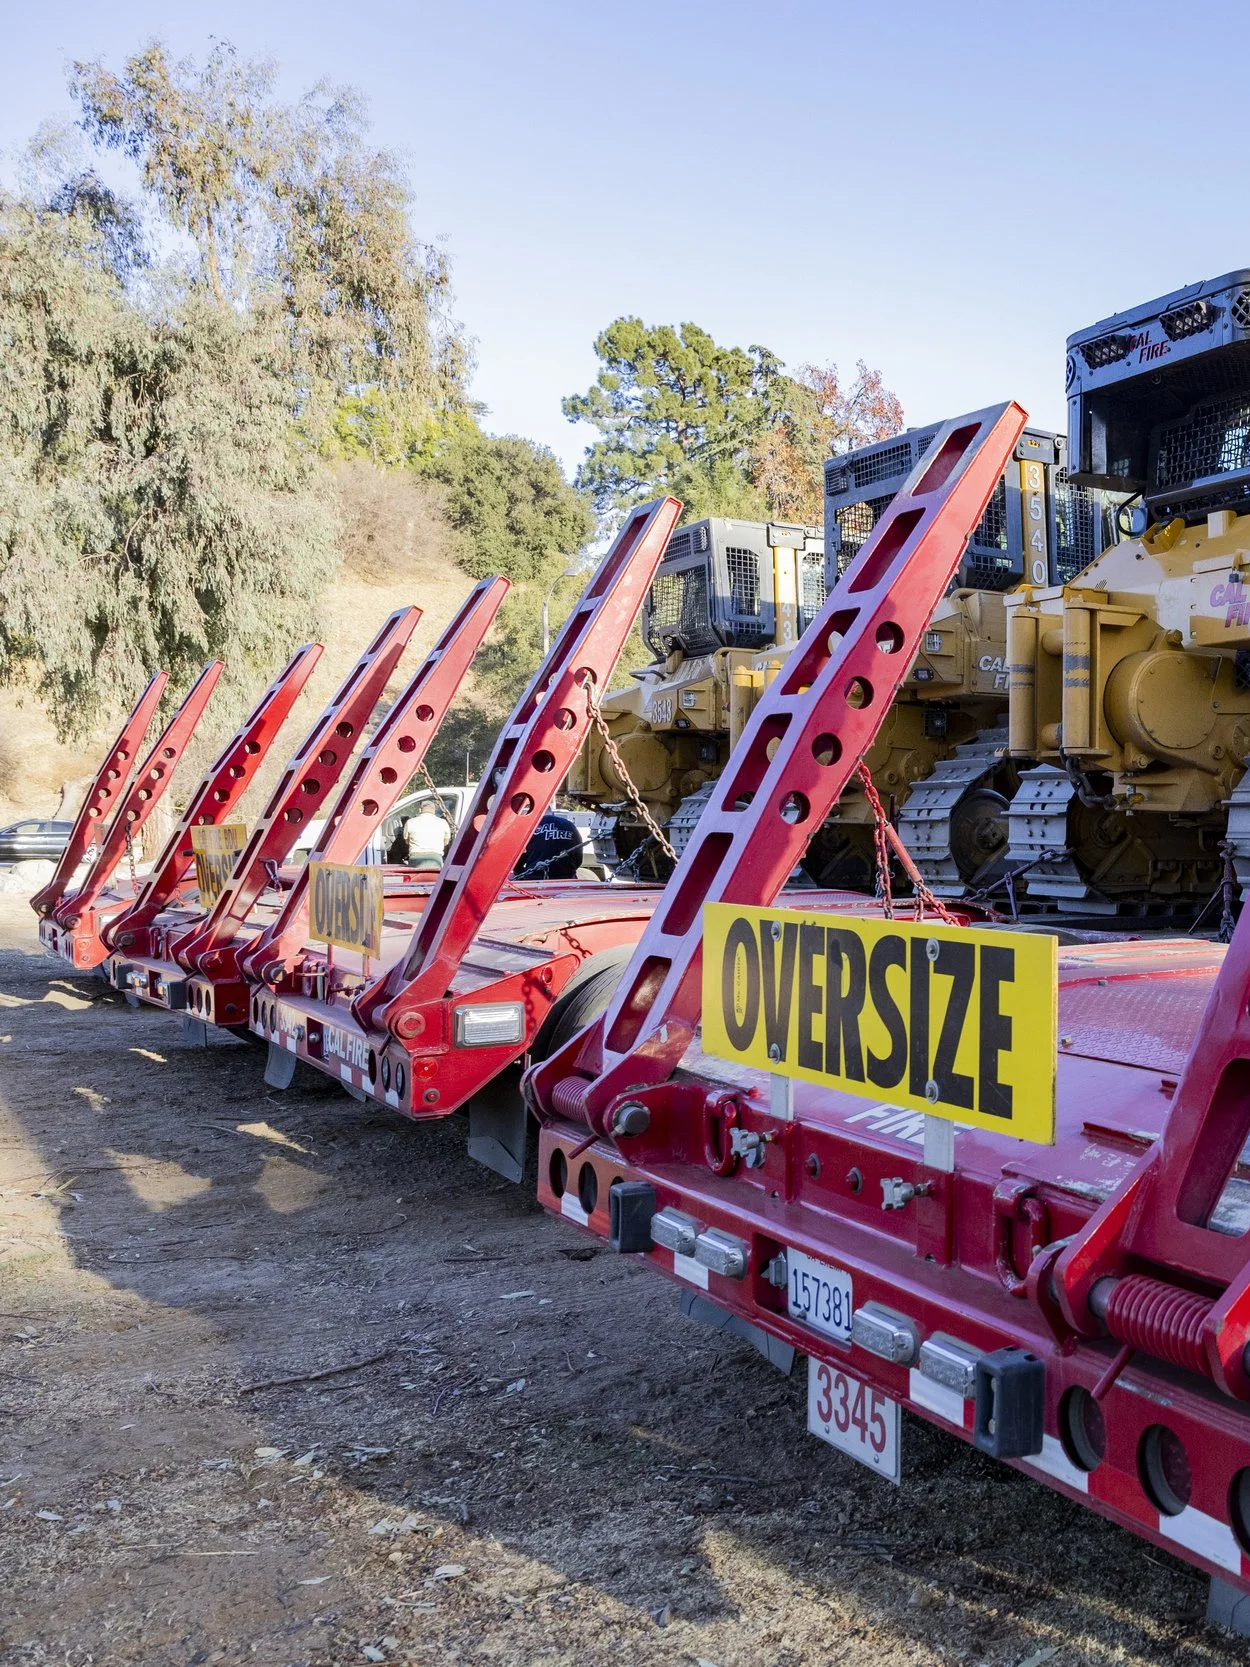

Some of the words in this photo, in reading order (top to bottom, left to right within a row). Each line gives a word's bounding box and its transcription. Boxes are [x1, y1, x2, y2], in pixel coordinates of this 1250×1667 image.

[1128, 330, 1152, 352] CAL
[1139, 340, 1169, 363] FIRE
[1028, 465, 1046, 584] 3540
[1210, 582, 1247, 608] CAL
[992, 672, 1010, 689] FI
[534, 822, 557, 835] CAL
[545, 829, 573, 840] FIRE
[722, 917, 1015, 1120] OVERSIZE
[329, 1025, 346, 1059] CAL
[346, 1033, 370, 1071] FIRE
[792, 1268, 852, 1331] 157381
[817, 1365, 887, 1453] 3345
